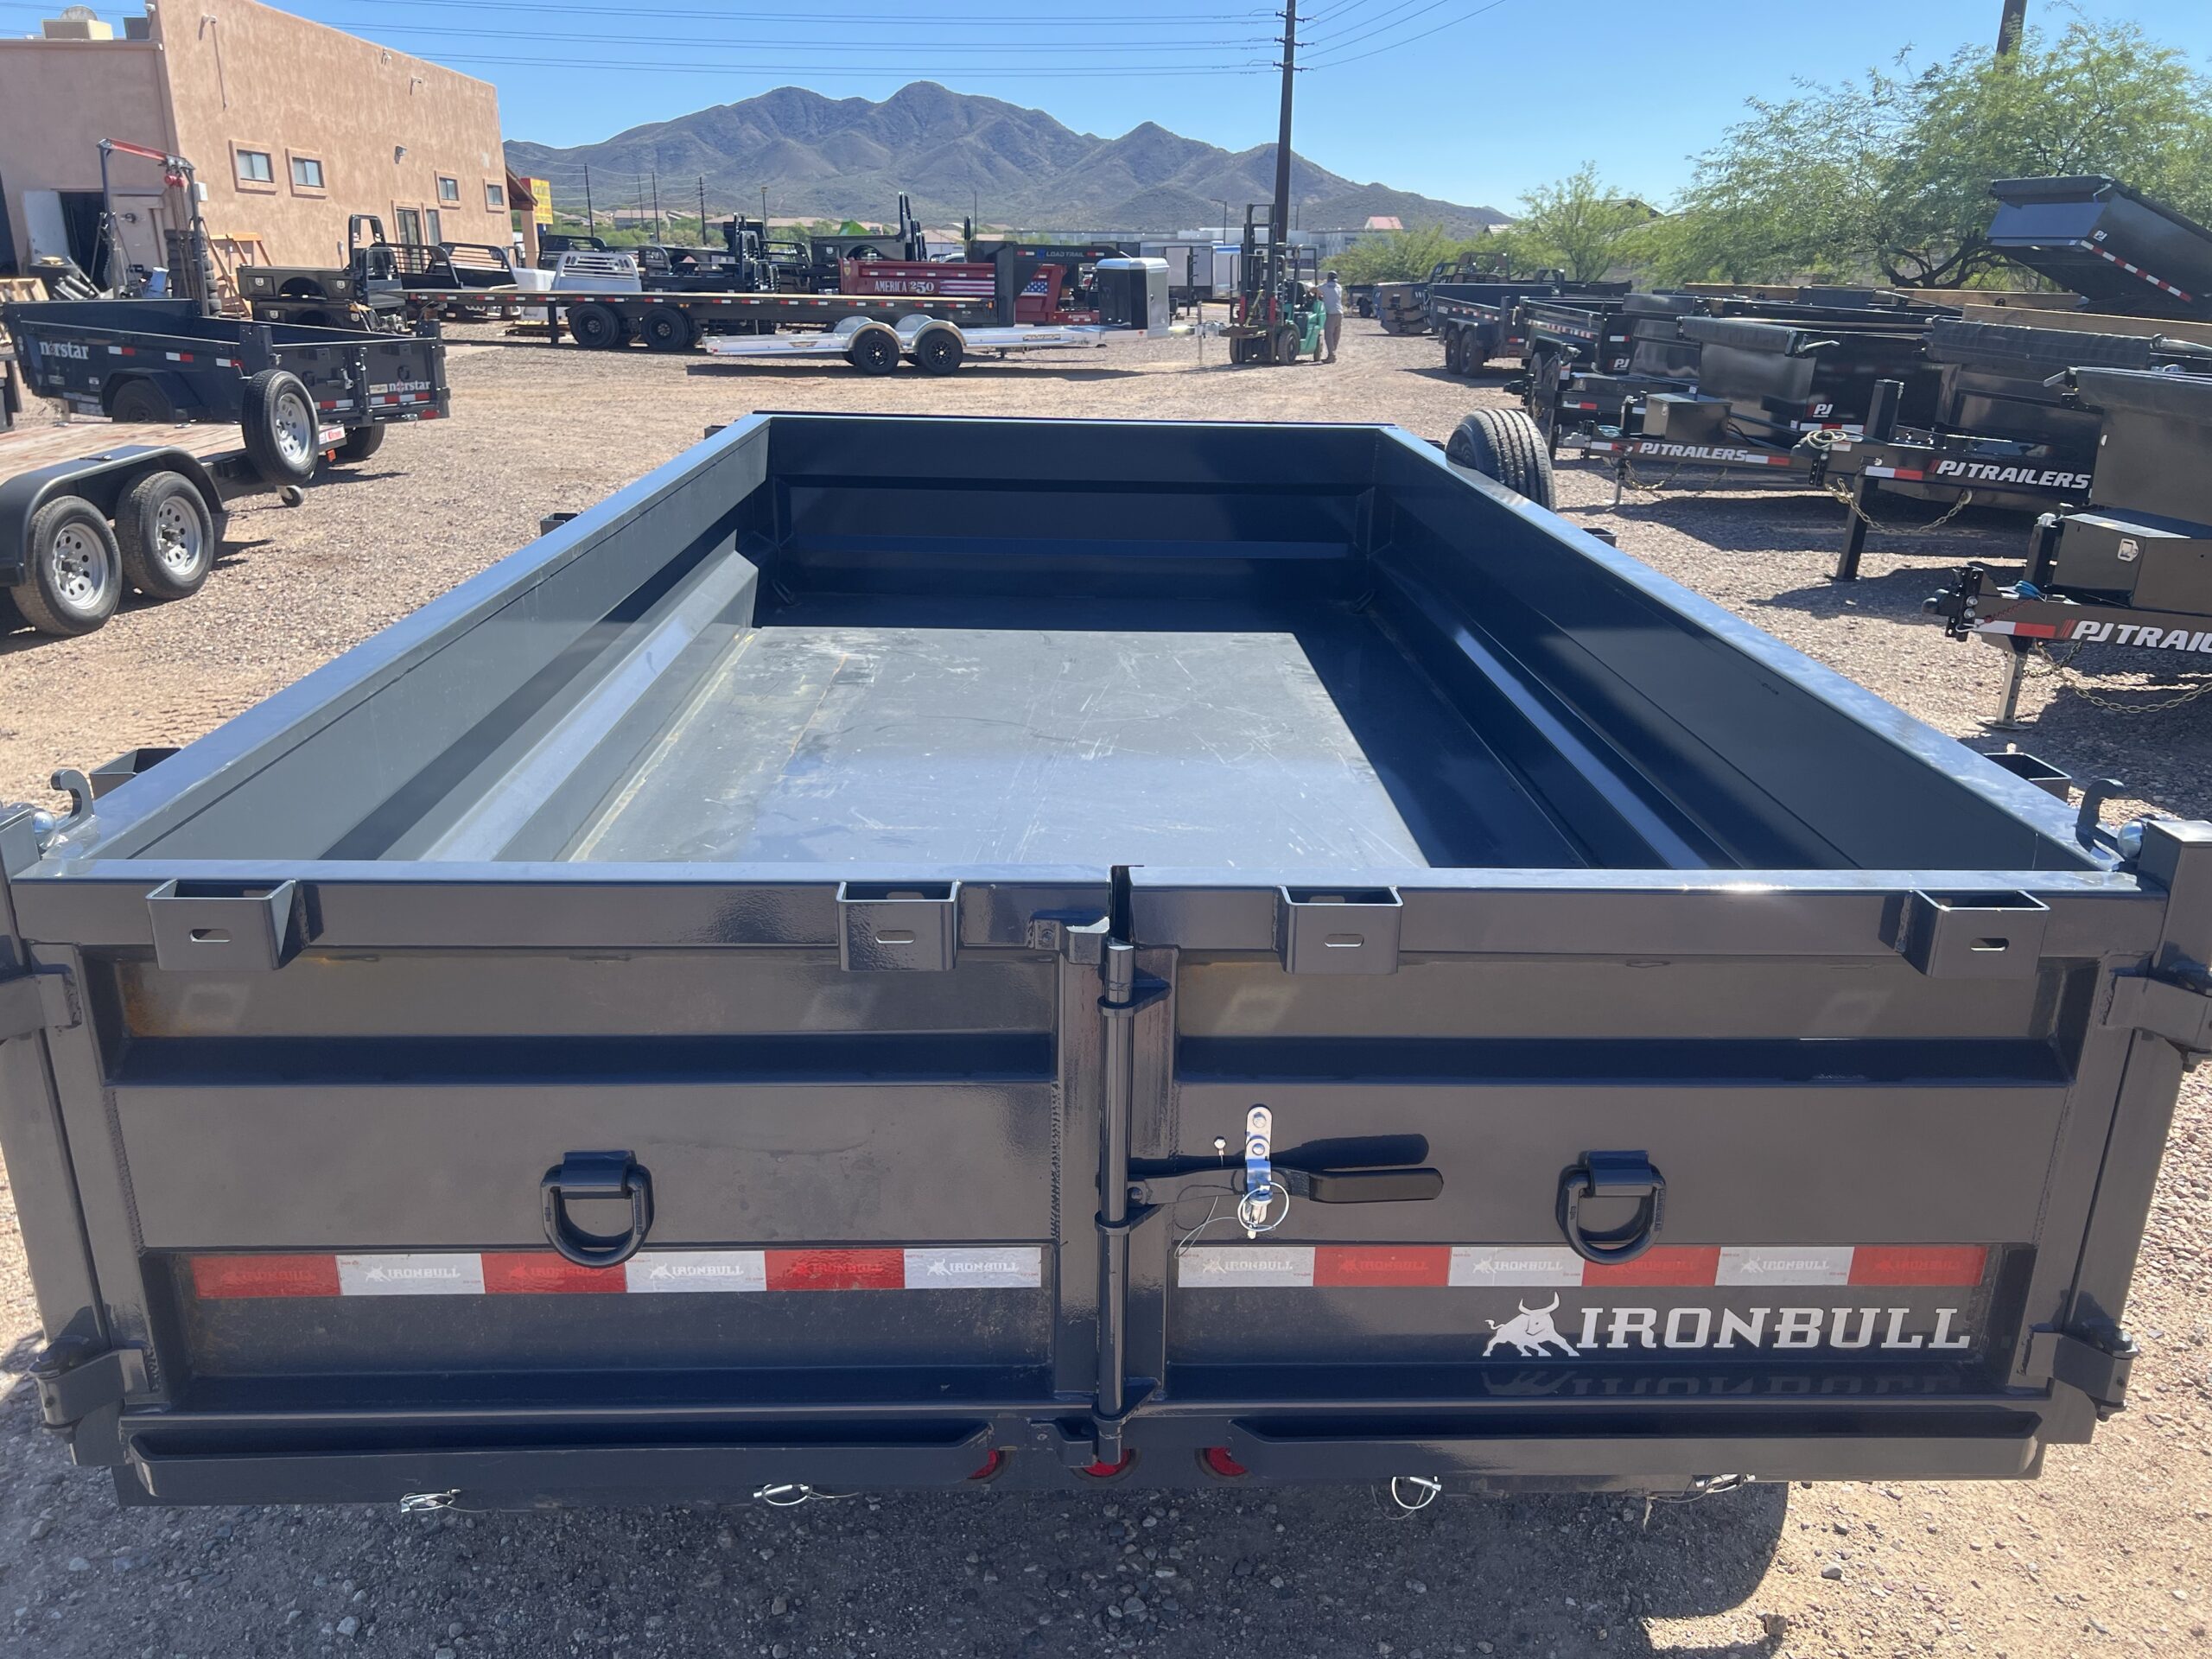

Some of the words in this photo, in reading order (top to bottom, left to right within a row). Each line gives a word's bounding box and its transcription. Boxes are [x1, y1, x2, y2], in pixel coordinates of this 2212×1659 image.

[2094, 230, 2107, 240] PJ
[874, 280, 907, 293] AMERICA
[910, 281, 935, 294] 250
[39, 340, 90, 360] norstar
[1613, 359, 1630, 368] PJ
[389, 380, 431, 391] norstar
[1814, 404, 1834, 415] PJ
[671, 1265, 744, 1276] IRONBULL
[950, 1262, 1020, 1273] IRONBULL
[1224, 1261, 1294, 1272] IRONBULL
[1494, 1261, 1563, 1272] IRONBULL
[1761, 1260, 1830, 1271] IRONBULL
[388, 1266, 461, 1280] IRONBULL
[1576, 1307, 1970, 1350] IRONBULL
